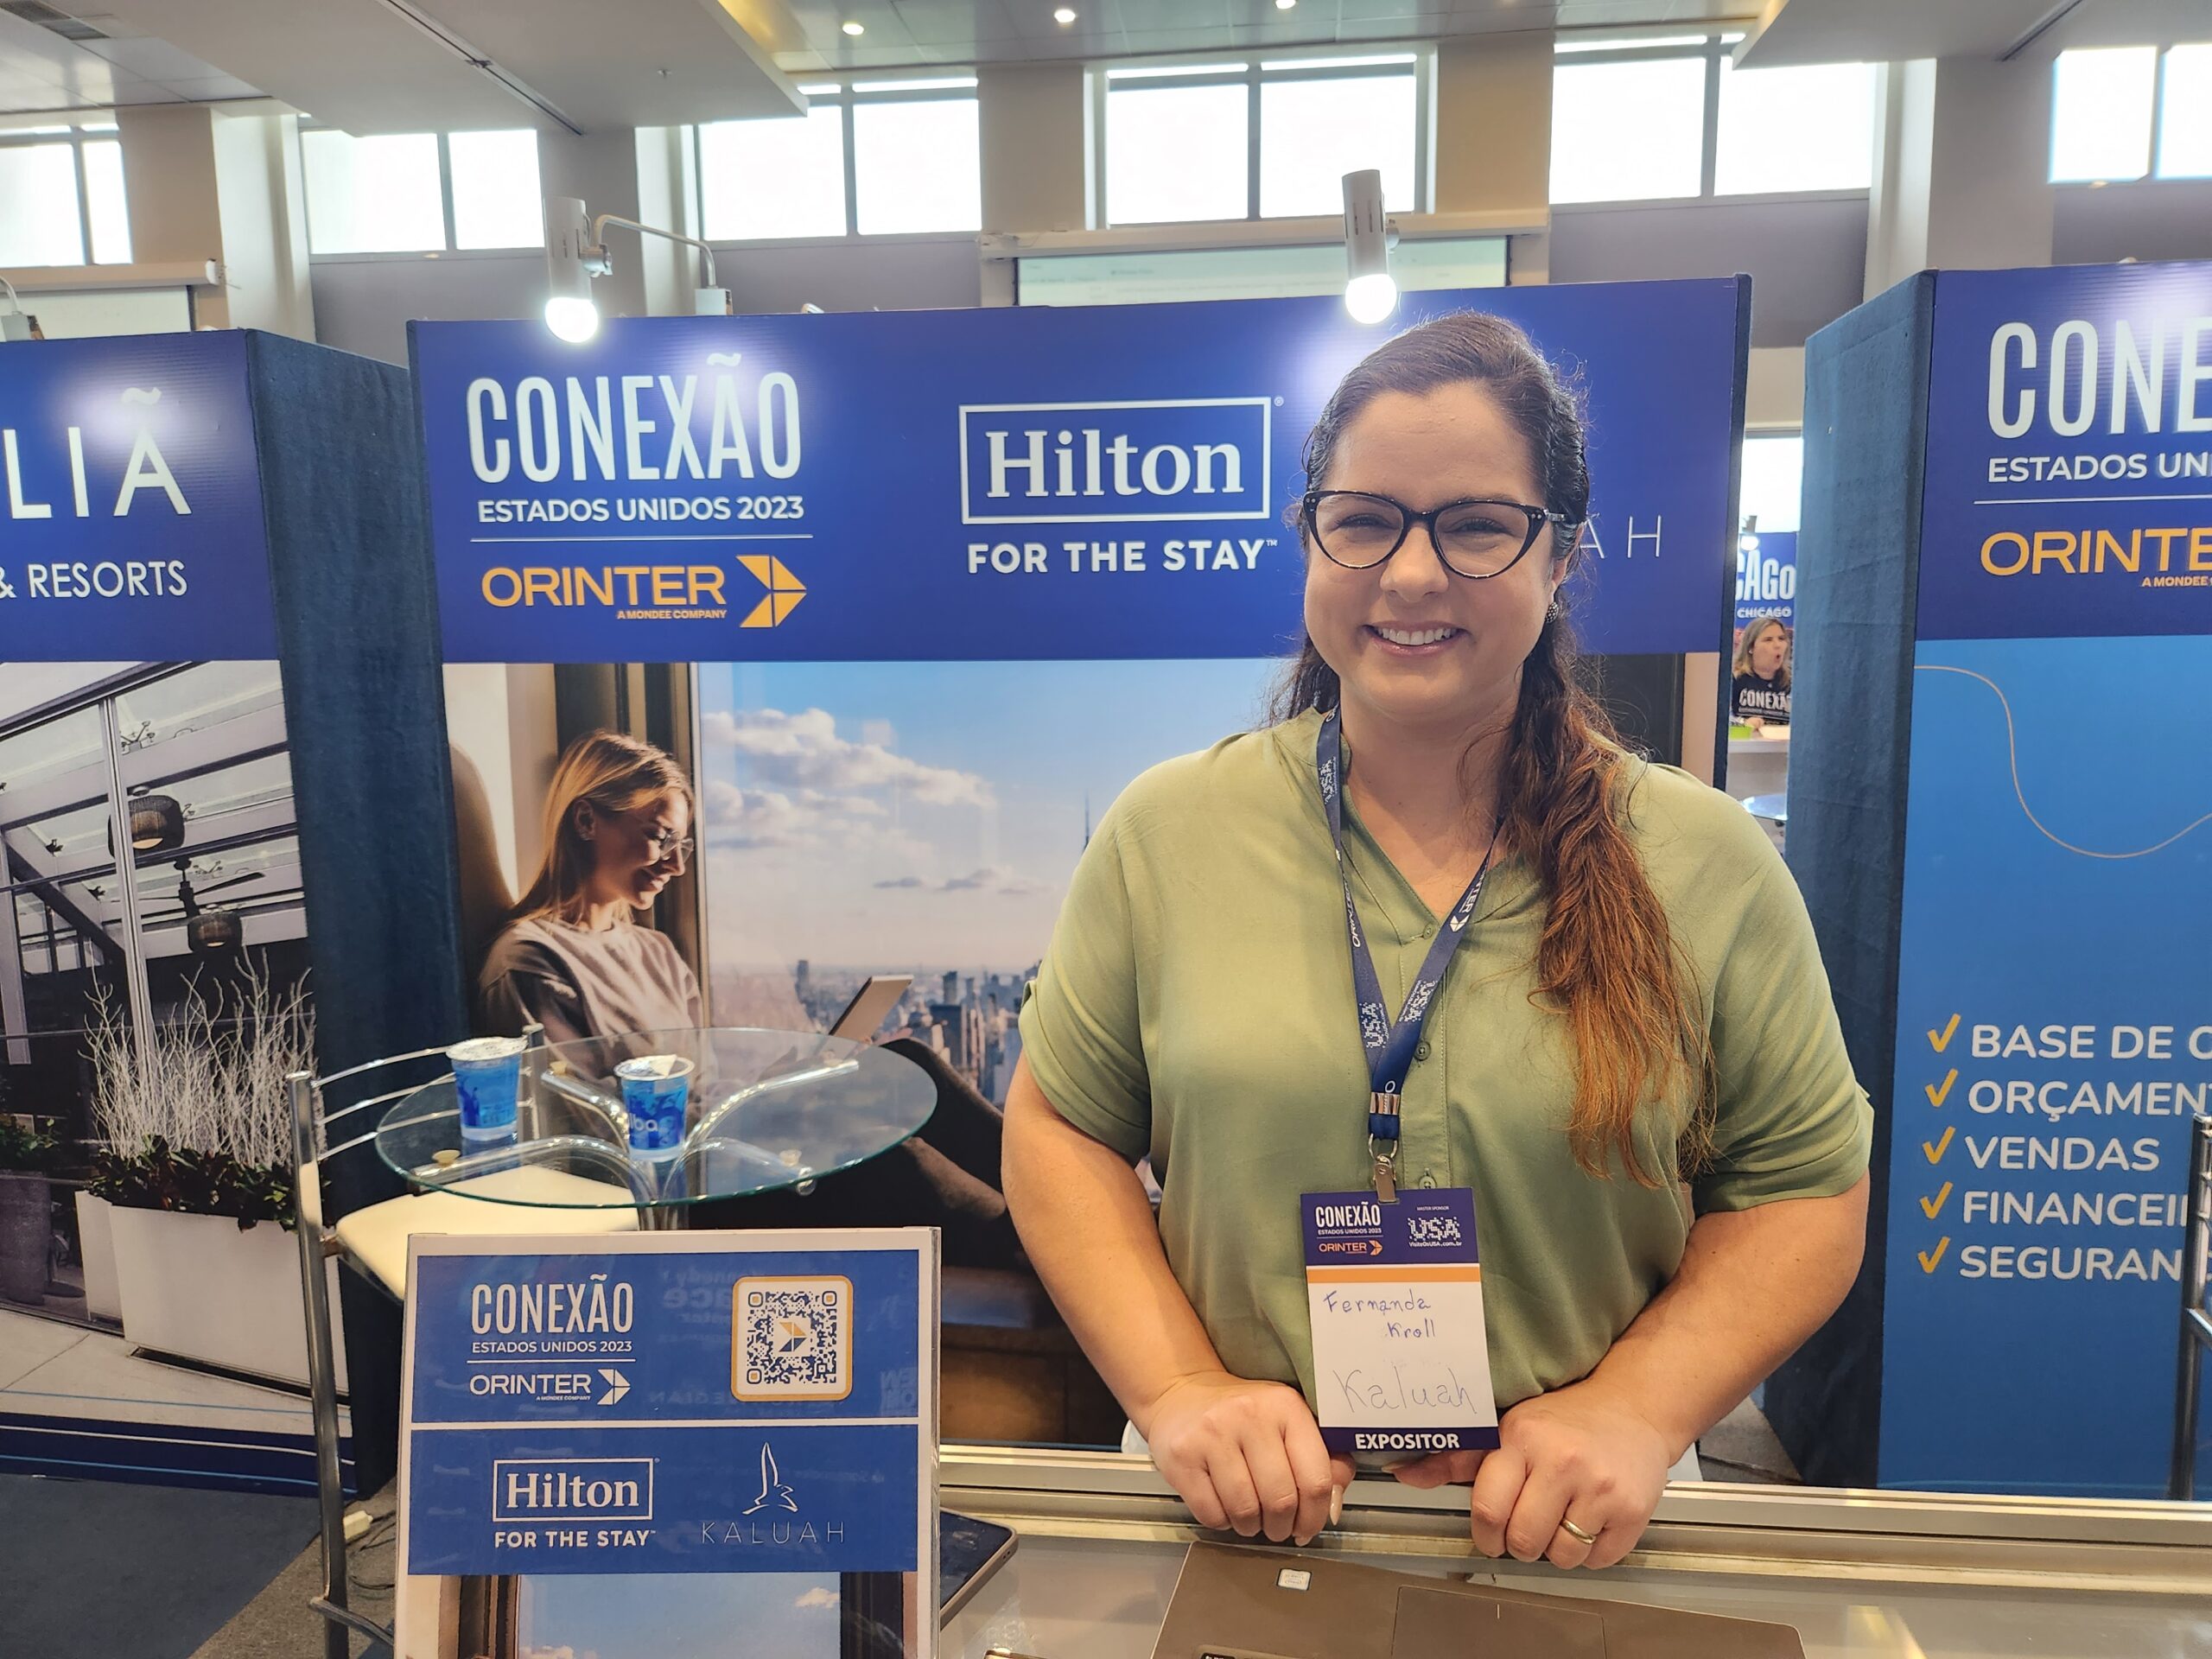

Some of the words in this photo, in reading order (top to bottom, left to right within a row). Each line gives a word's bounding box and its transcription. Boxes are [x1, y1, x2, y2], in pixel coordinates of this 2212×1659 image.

[1988, 317, 2212, 439] CONE
[467, 353, 801, 483] CONEXÃO
[985, 429, 1244, 499] Hilton
[1988, 454, 2148, 482] ESTADOS
[2158, 451, 2212, 478] UN
[478, 498, 610, 523] ESTADOS
[617, 497, 731, 522] UNIDOS
[737, 496, 804, 520] 2023
[968, 542, 1048, 574] FOR
[1063, 540, 1147, 572] THE
[28, 560, 188, 598] RESORTS
[481, 566, 727, 607] ORINTER
[2142, 576, 2152, 587] A
[2153, 575, 2209, 587] MONDEE
[617, 610, 626, 620] A
[626, 610, 672, 620] MONDEE
[673, 609, 727, 619] COMPANY
[1737, 605, 1792, 619] CHICAGO
[1971, 1025, 2095, 1058] BASE
[2111, 1026, 2174, 1059] DE
[1968, 1080, 2212, 1122] ORÇAMEN
[1964, 1136, 2160, 1172] VENDAS
[1315, 1201, 1381, 1228] CONEXÃO
[1963, 1191, 2189, 1227] FINANCEI
[1408, 1216, 1461, 1241] USA
[1319, 1242, 1367, 1252] ORINTER
[1960, 1245, 2184, 1281] SEGURAN
[471, 1274, 633, 1334] CONEXÃO
[1324, 1288, 1431, 1315] Fernanda
[1386, 1318, 1436, 1338] Kroll
[472, 1342, 537, 1354] ESTADOS
[541, 1341, 596, 1353] UNIDOS
[600, 1340, 632, 1352] 2023
[469, 1374, 592, 1395] ORINTER
[1332, 1365, 1477, 1415] Kaluah
[1355, 1433, 1460, 1450] EXPOSITOR
[506, 1472, 639, 1509] Hilton
[494, 1531, 537, 1549] FOR
[545, 1530, 588, 1548] THE
[702, 1522, 844, 1544] KALUAH
